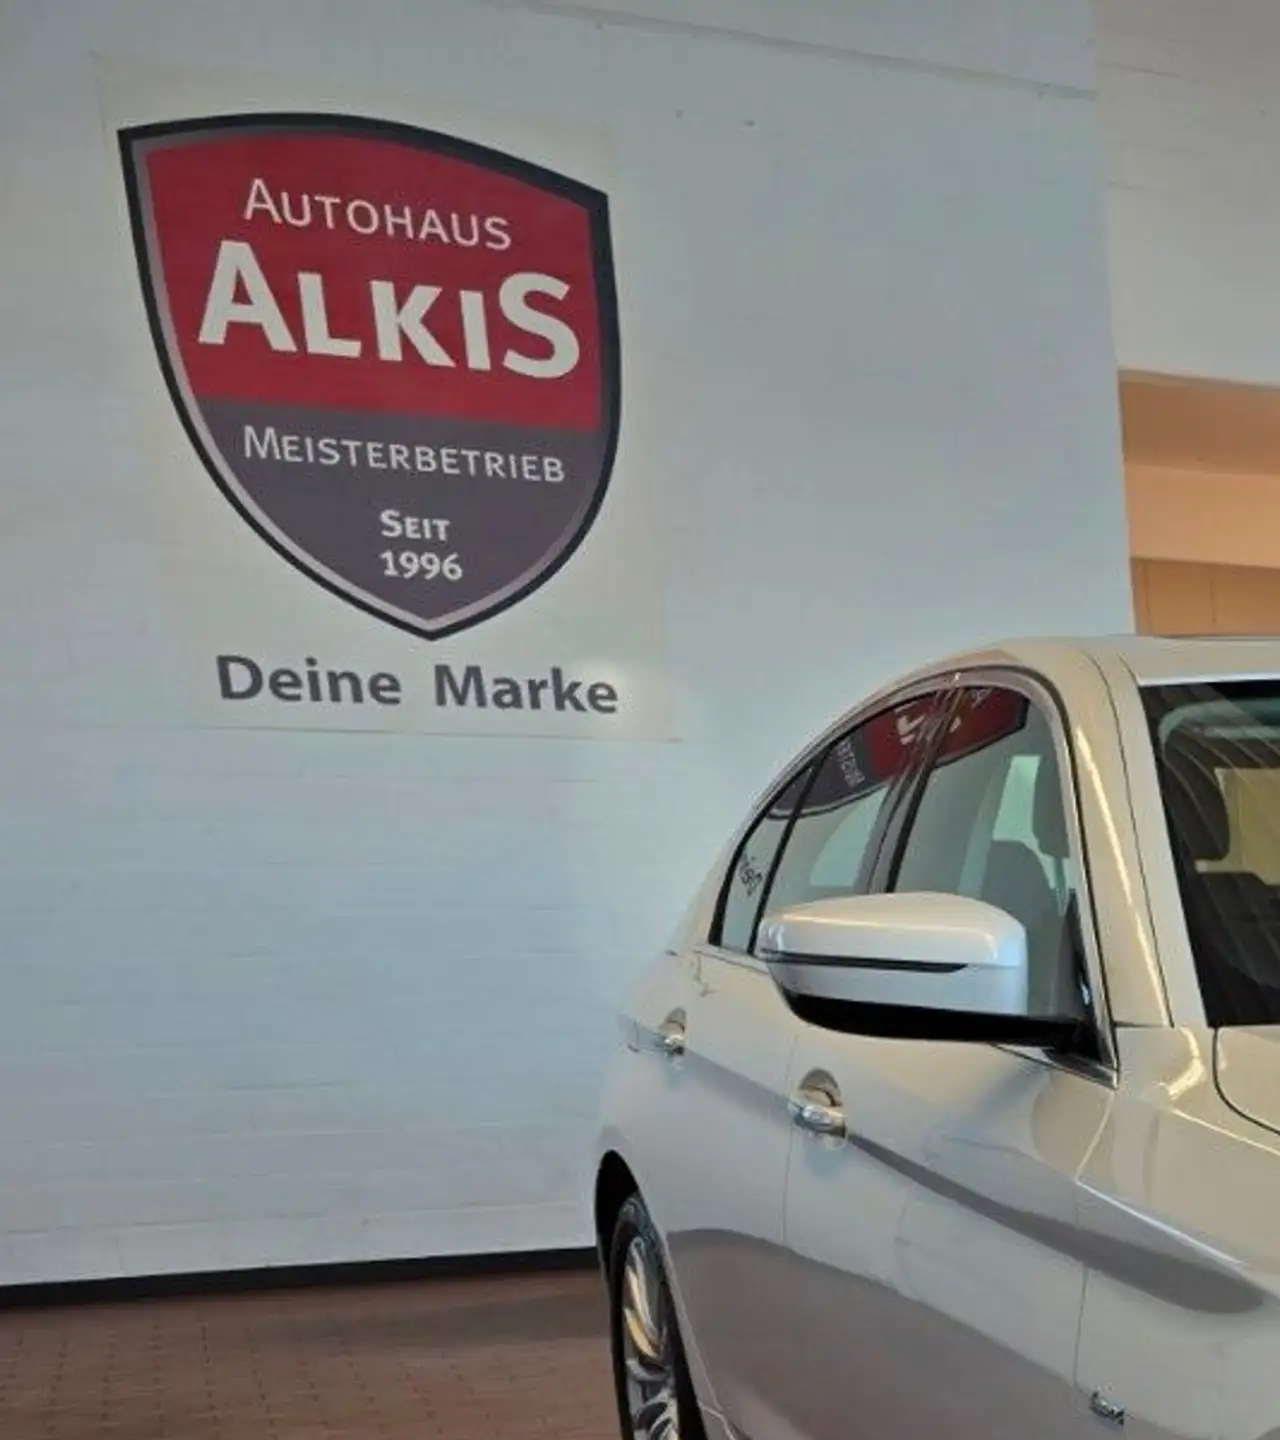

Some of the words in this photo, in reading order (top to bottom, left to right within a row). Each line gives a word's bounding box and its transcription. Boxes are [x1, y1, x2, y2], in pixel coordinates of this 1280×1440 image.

[243, 178, 512, 250] AUTOHAUS
[244, 425, 565, 482] MEISTERBETRIEB
[381, 509, 449, 541] SEIT
[381, 550, 463, 581] 1996
[216, 654, 402, 703] Deine
[434, 663, 619, 714] Marke
